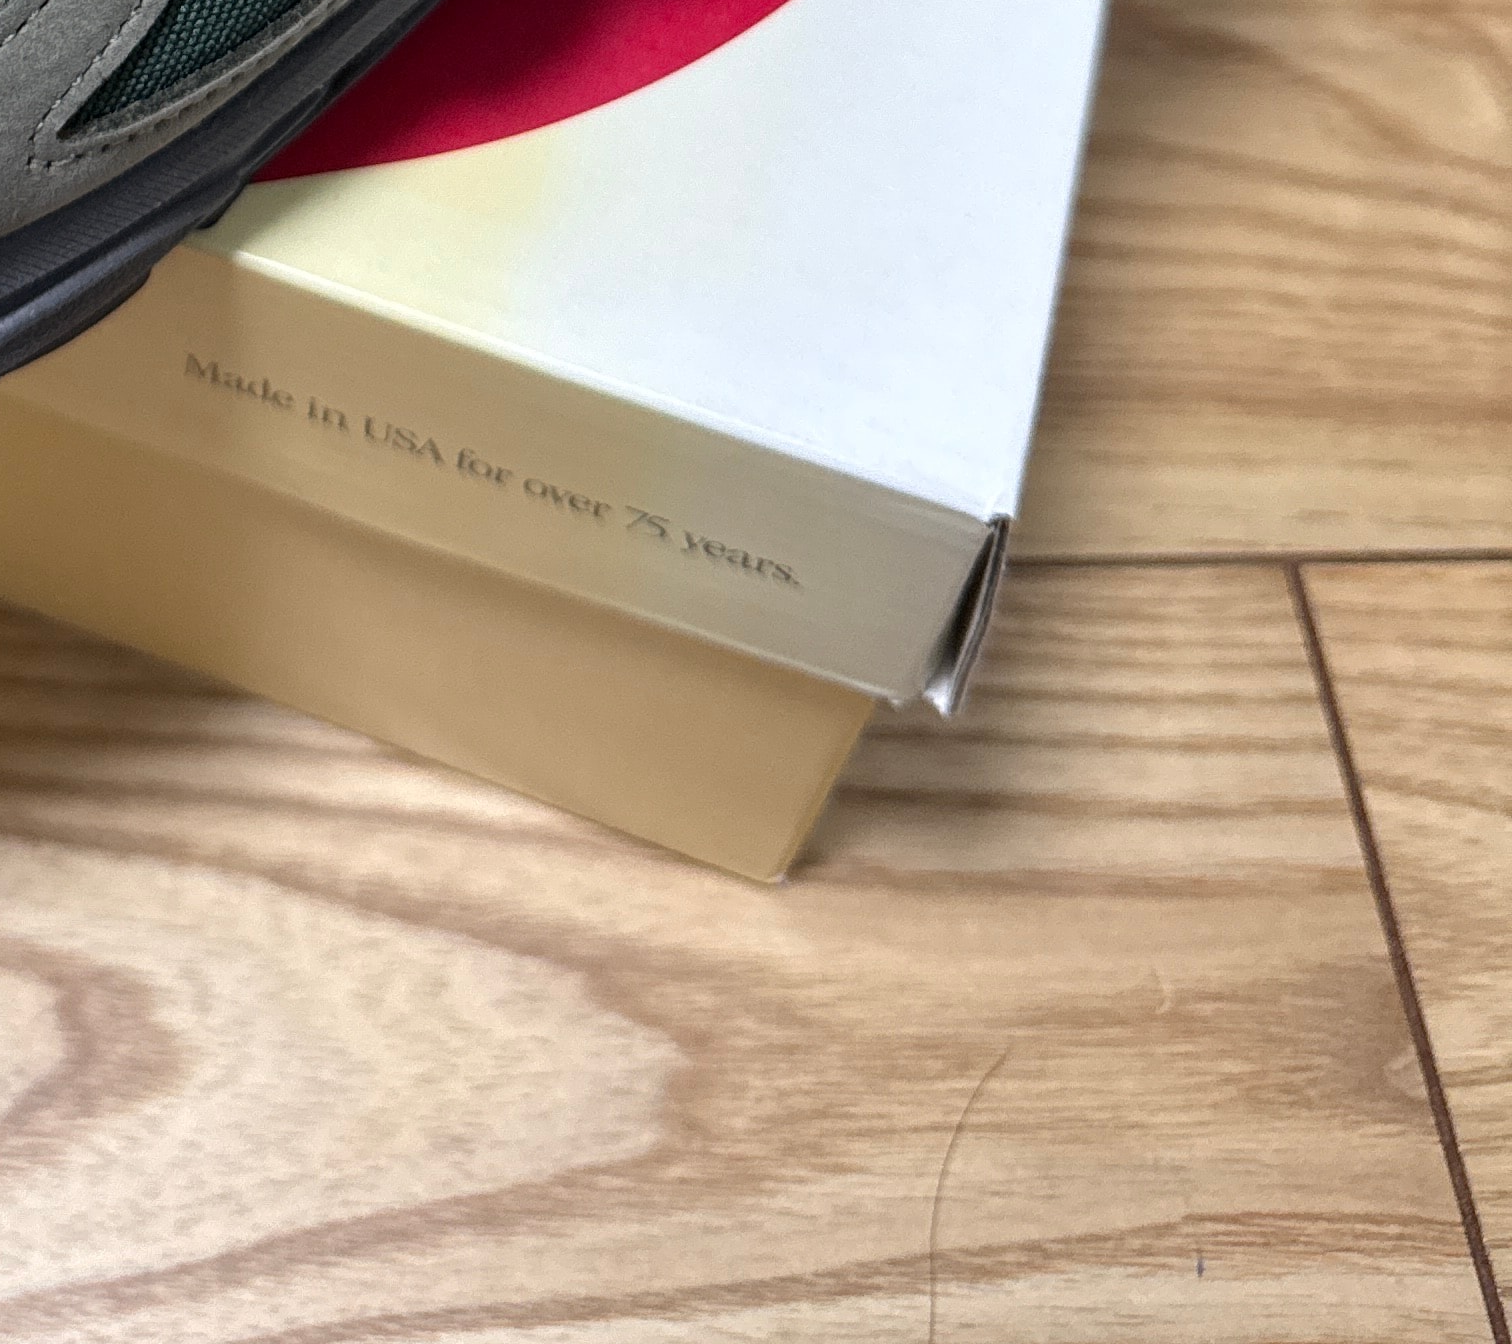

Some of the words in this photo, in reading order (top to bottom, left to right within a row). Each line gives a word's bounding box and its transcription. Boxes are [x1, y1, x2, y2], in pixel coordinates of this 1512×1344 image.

[183, 350, 296, 410] Made
[306, 395, 349, 433] in
[363, 414, 445, 468] USA
[456, 446, 514, 487] for
[521, 476, 613, 522] over
[623, 504, 672, 541] 75
[680, 525, 806, 588] years.
